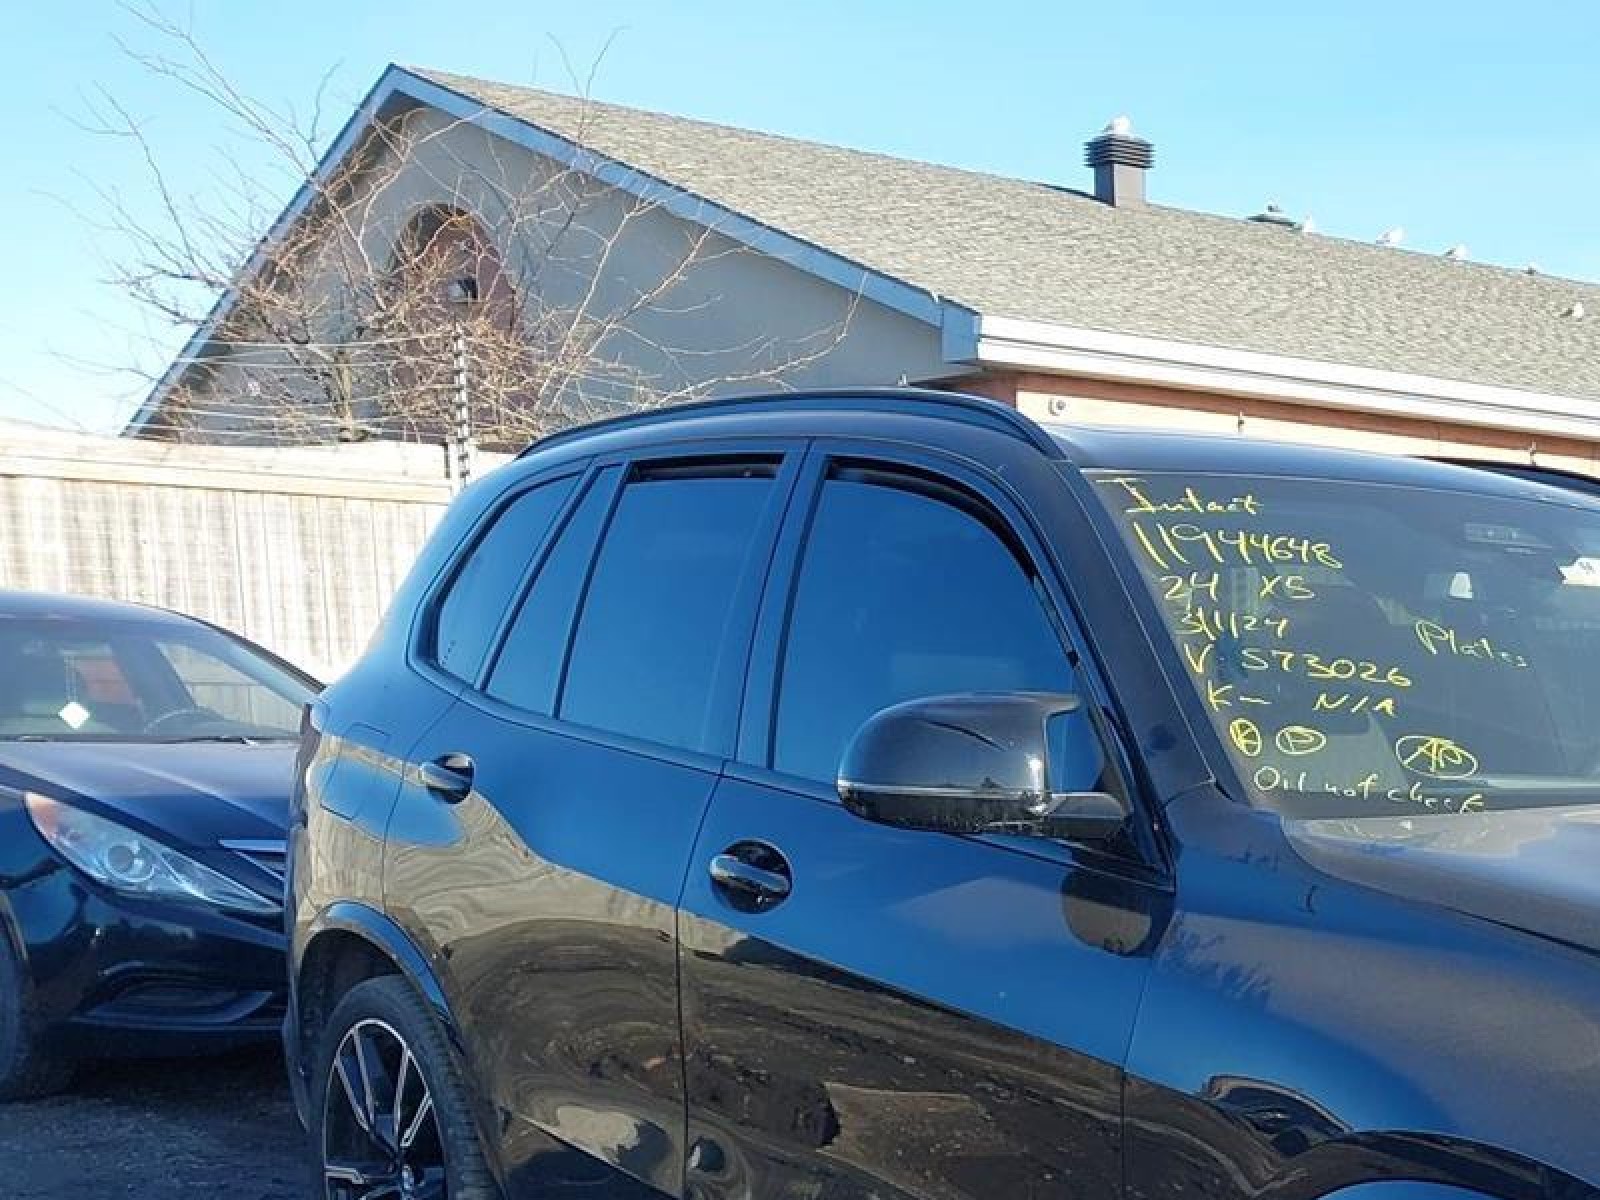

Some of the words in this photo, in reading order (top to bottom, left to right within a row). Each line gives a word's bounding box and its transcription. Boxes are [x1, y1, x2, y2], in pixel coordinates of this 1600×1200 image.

[1096, 477, 1265, 515] Intact
[1132, 521, 1344, 569] 11944648
[1159, 571, 1220, 602] 24
[1254, 765, 1308, 792] Oil
